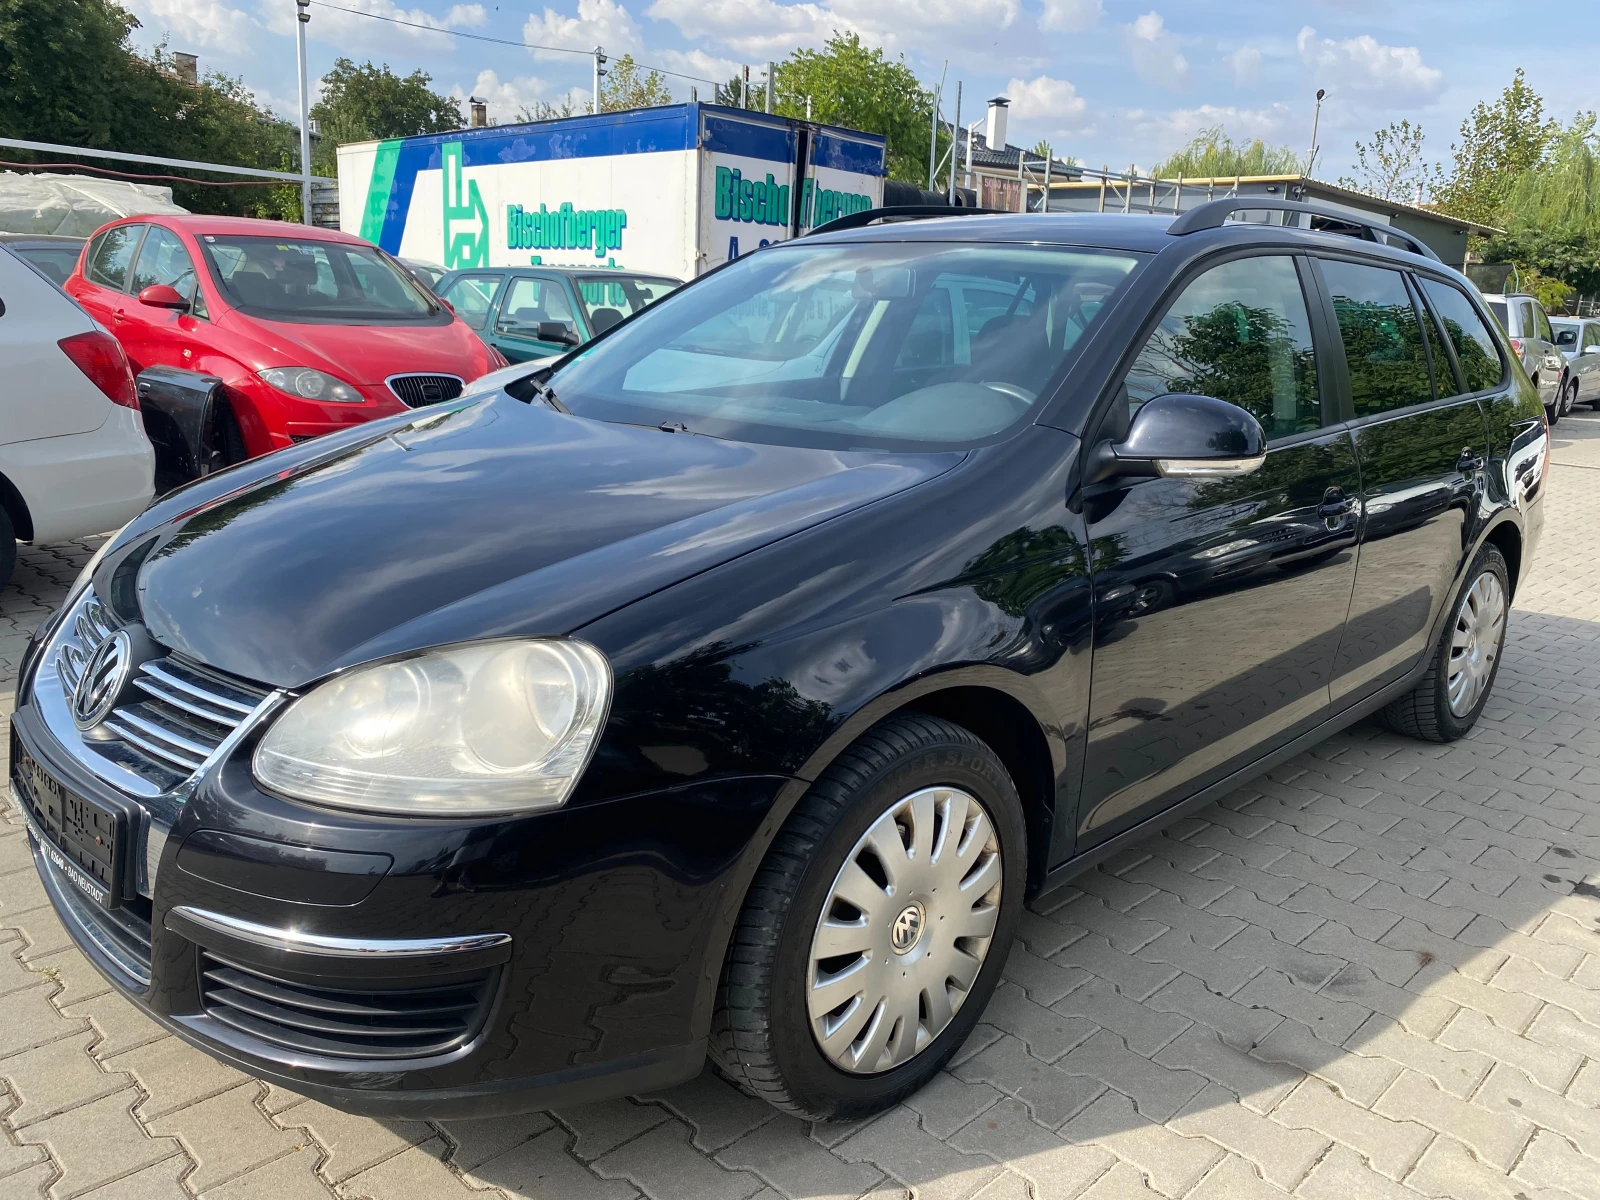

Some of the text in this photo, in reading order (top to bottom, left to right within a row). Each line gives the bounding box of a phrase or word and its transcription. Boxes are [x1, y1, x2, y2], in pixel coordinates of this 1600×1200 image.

[507, 202, 627, 257] Bischofberger
[943, 750, 1002, 787] SPORT
[68, 866, 78, 882] BAD
[78, 877, 103, 903] NEUSTADT
